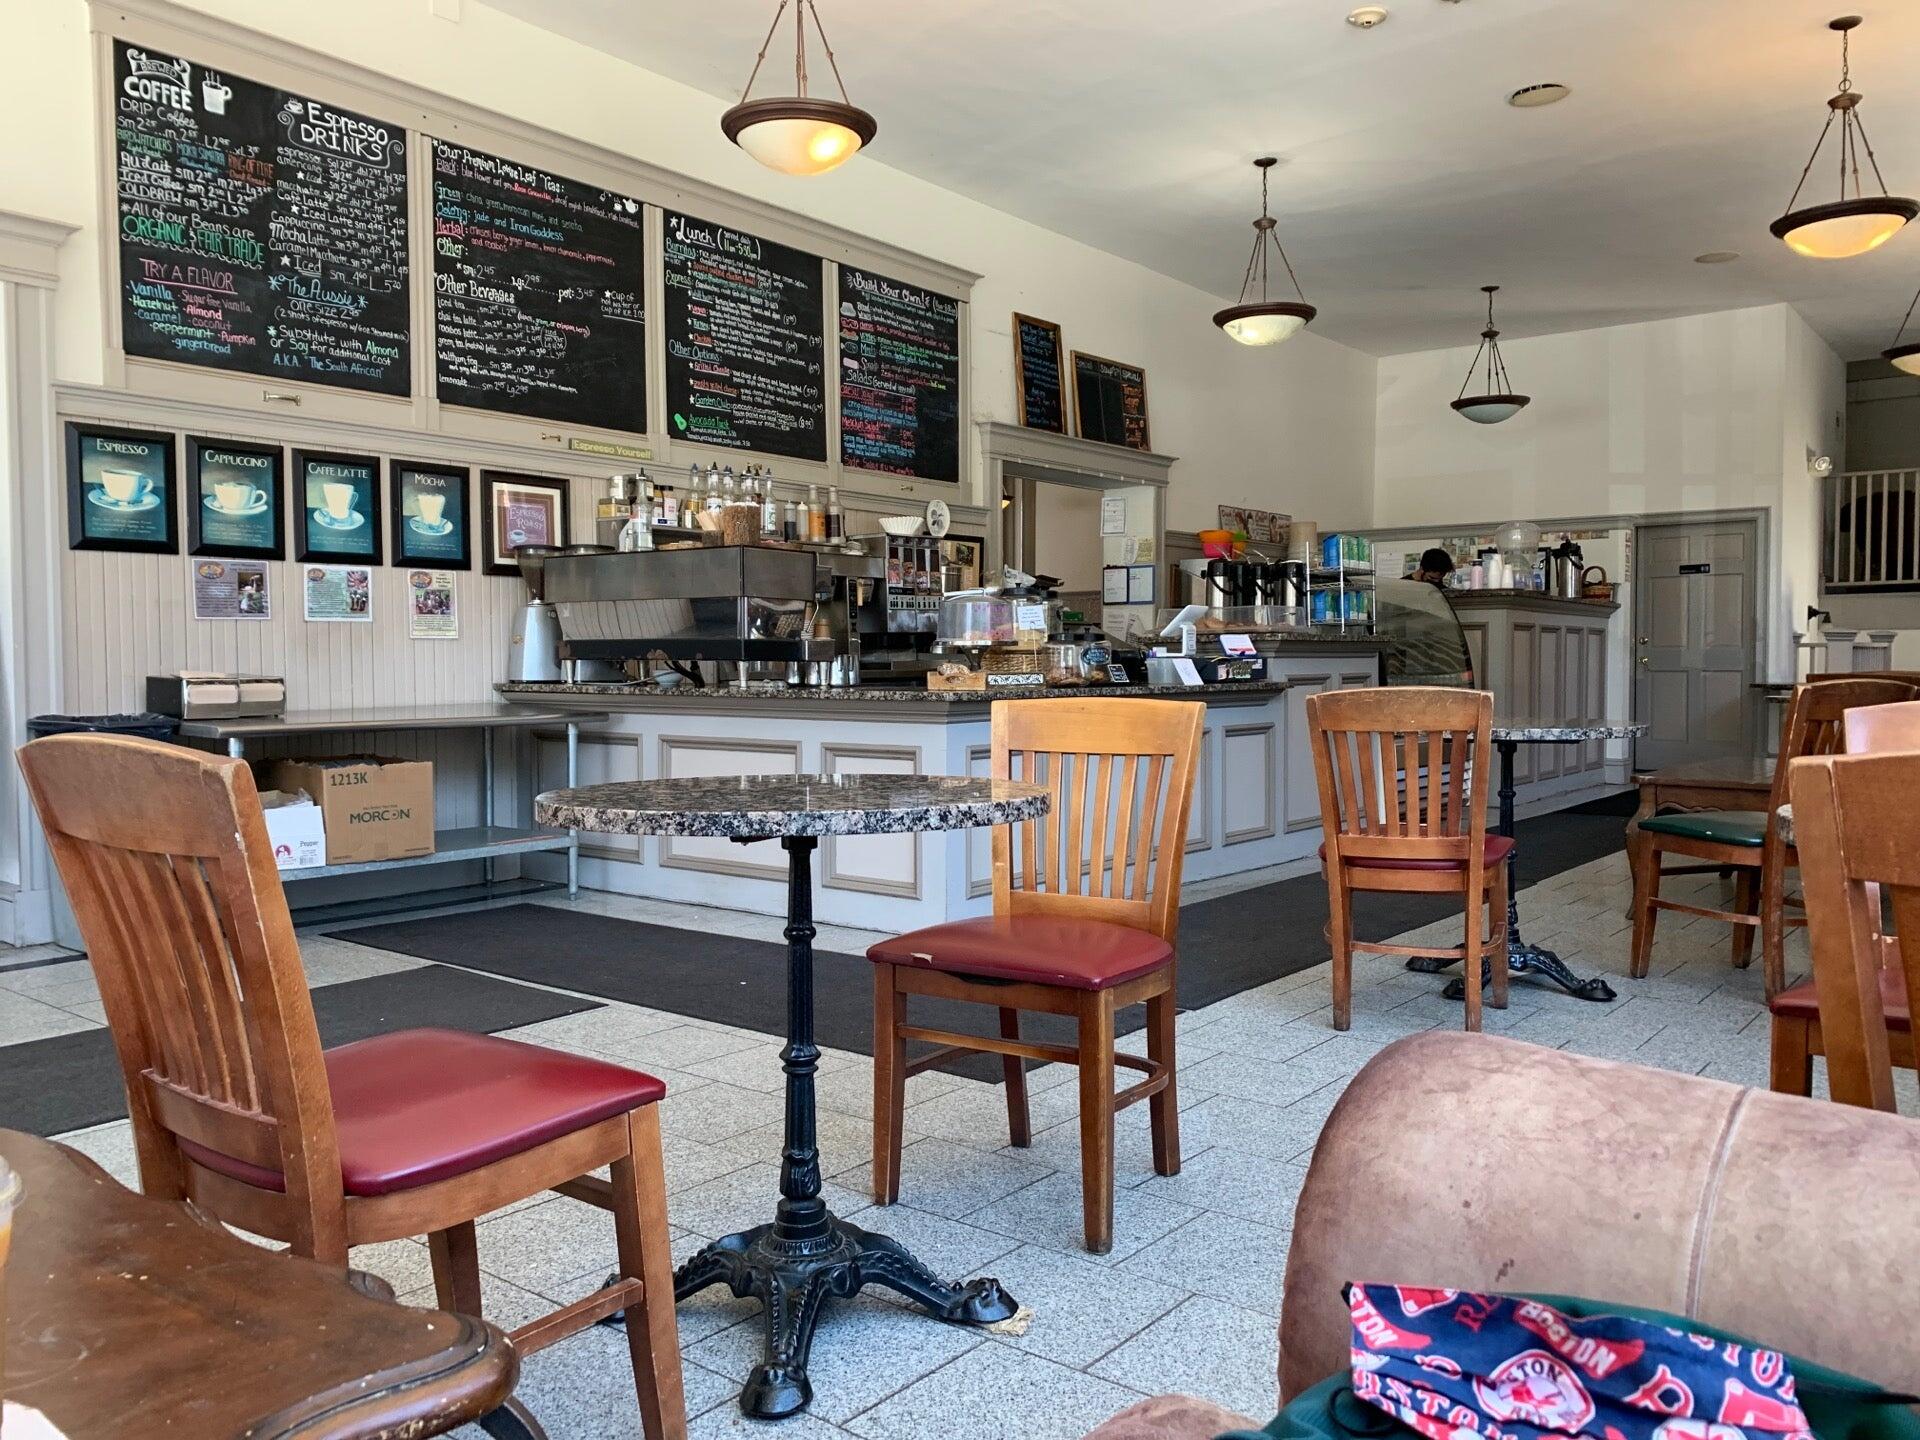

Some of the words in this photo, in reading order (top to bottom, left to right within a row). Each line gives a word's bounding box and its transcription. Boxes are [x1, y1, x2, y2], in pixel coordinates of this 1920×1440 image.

[124, 76, 194, 112] COFFEE
[120, 97, 153, 115] DRIP
[157, 107, 198, 129] Coffee
[308, 102, 388, 146] Espresso
[301, 124, 382, 161] DRINKS
[519, 168, 538, 187] Leaf
[131, 202, 149, 216] All
[167, 212, 188, 224] our
[192, 213, 230, 236] Beans
[232, 228, 255, 240] are
[327, 210, 353, 227] Latte
[123, 215, 187, 245] ORGANIC
[198, 230, 224, 254] FAIR
[224, 236, 265, 264] TRADE
[269, 223, 307, 244] Mocha
[510, 218, 529, 234] Iron
[530, 221, 564, 241] Goddess
[675, 217, 716, 246] Lunch
[269, 238, 309, 258] Caramel
[293, 255, 321, 272] Iced
[139, 258, 168, 278] TRY
[172, 266, 183, 281] A
[187, 267, 234, 291] FLAVOR
[130, 280, 173, 300] Vanilla
[278, 275, 310, 298] The
[310, 279, 357, 307] Aussie
[437, 274, 468, 295] Other
[469, 279, 515, 304] Beverages
[186, 305, 222, 319] Almond
[270, 338, 284, 348] or
[289, 339, 309, 355] Soy
[310, 341, 327, 353] for
[329, 347, 370, 362] additional
[279, 324, 336, 345] Substitute
[340, 339, 362, 351] with
[365, 340, 398, 358] Almond
[669, 339, 690, 357] Other
[96, 439, 148, 456] ESPRESSO
[575, 440, 615, 454] Espresso
[617, 446, 651, 459] Yourself
[205, 450, 268, 468] CAPPUCCINO
[338, 467, 369, 480] LATTE
[415, 473, 447, 487] MOCHA
[518, 519, 545, 531] ROAST
[330, 772, 368, 786] 1213K
[350, 809, 410, 824] MORCON
[1519, 1301, 1617, 1372] BOSTON
